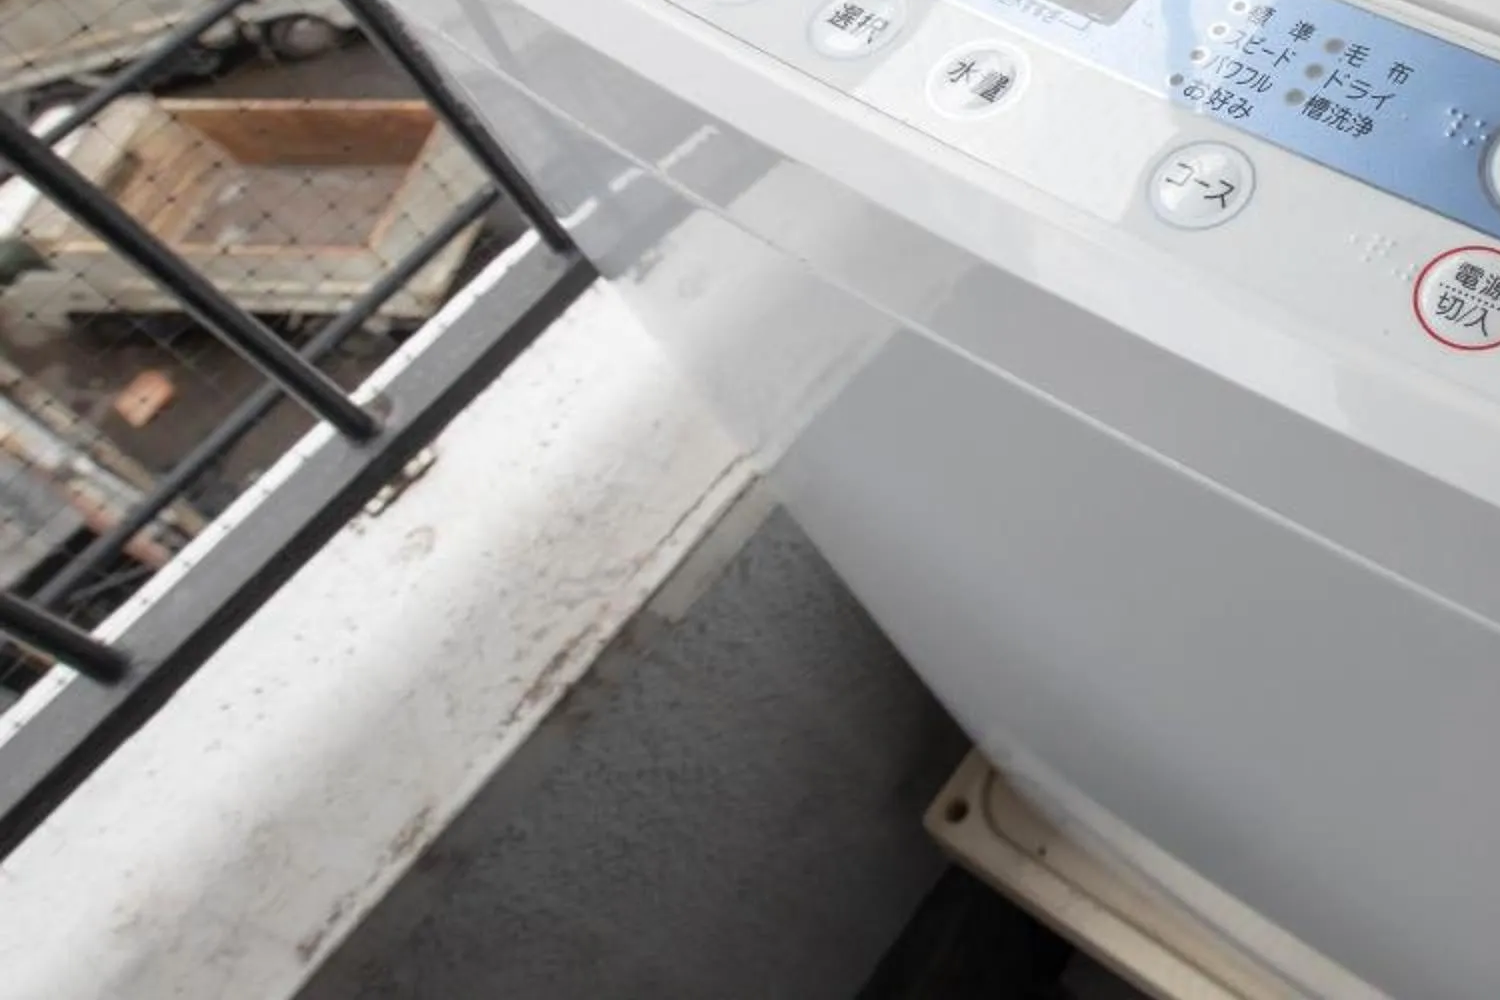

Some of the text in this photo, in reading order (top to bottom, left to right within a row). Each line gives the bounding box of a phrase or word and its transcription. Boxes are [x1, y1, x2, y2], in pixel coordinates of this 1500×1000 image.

[826, 2, 889, 44] 選択
[1224, 30, 1297, 68] スピード
[947, 57, 1010, 103] 水量
[1203, 53, 1274, 94] パワフル
[1322, 68, 1396, 111] ドライ
[1183, 80, 1255, 120] お好み
[1301, 93, 1375, 138] 槽洗浄
[1165, 162, 1235, 209] コース
[1435, 292, 1489, 338] 切/入
